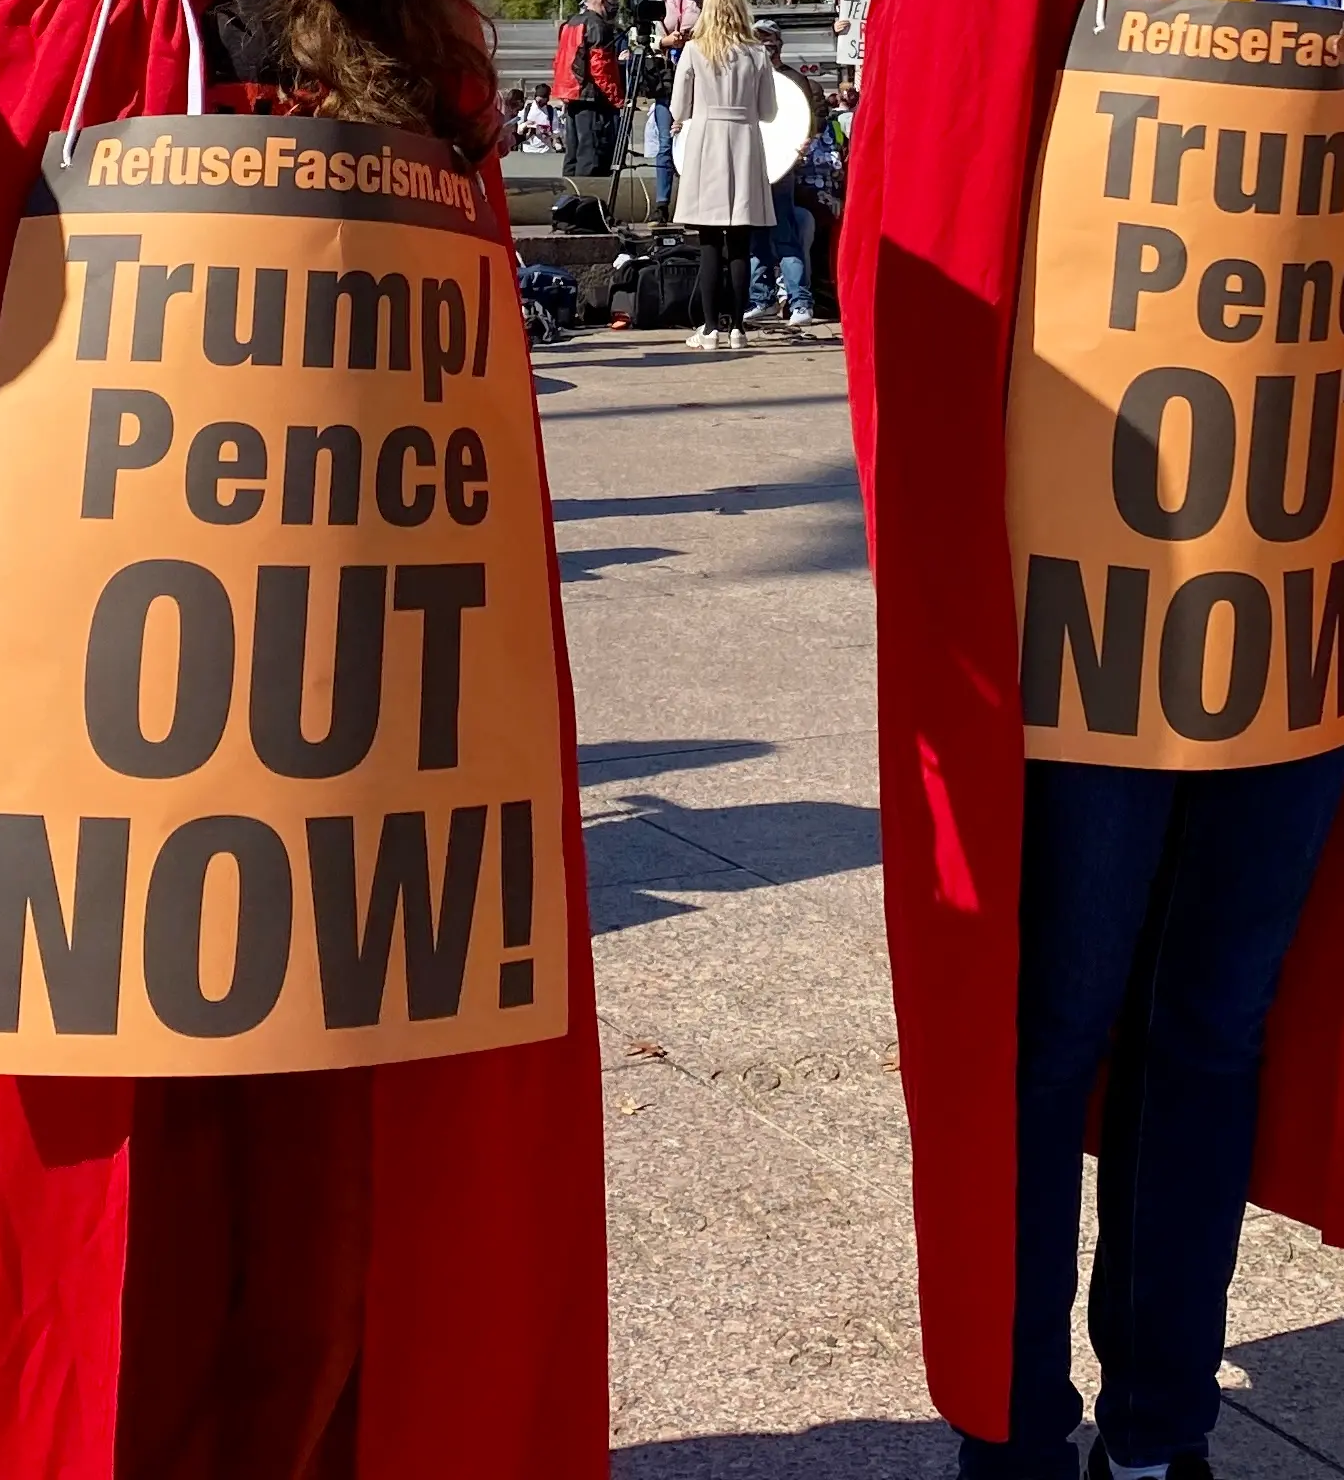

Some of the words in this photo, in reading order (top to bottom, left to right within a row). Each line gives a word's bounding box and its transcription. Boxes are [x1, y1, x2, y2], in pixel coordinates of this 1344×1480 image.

[88, 135, 475, 222] RefuseFascism.org
[65, 234, 491, 403] Trump/
[80, 388, 489, 527] Pence
[83, 559, 486, 781] OUT
